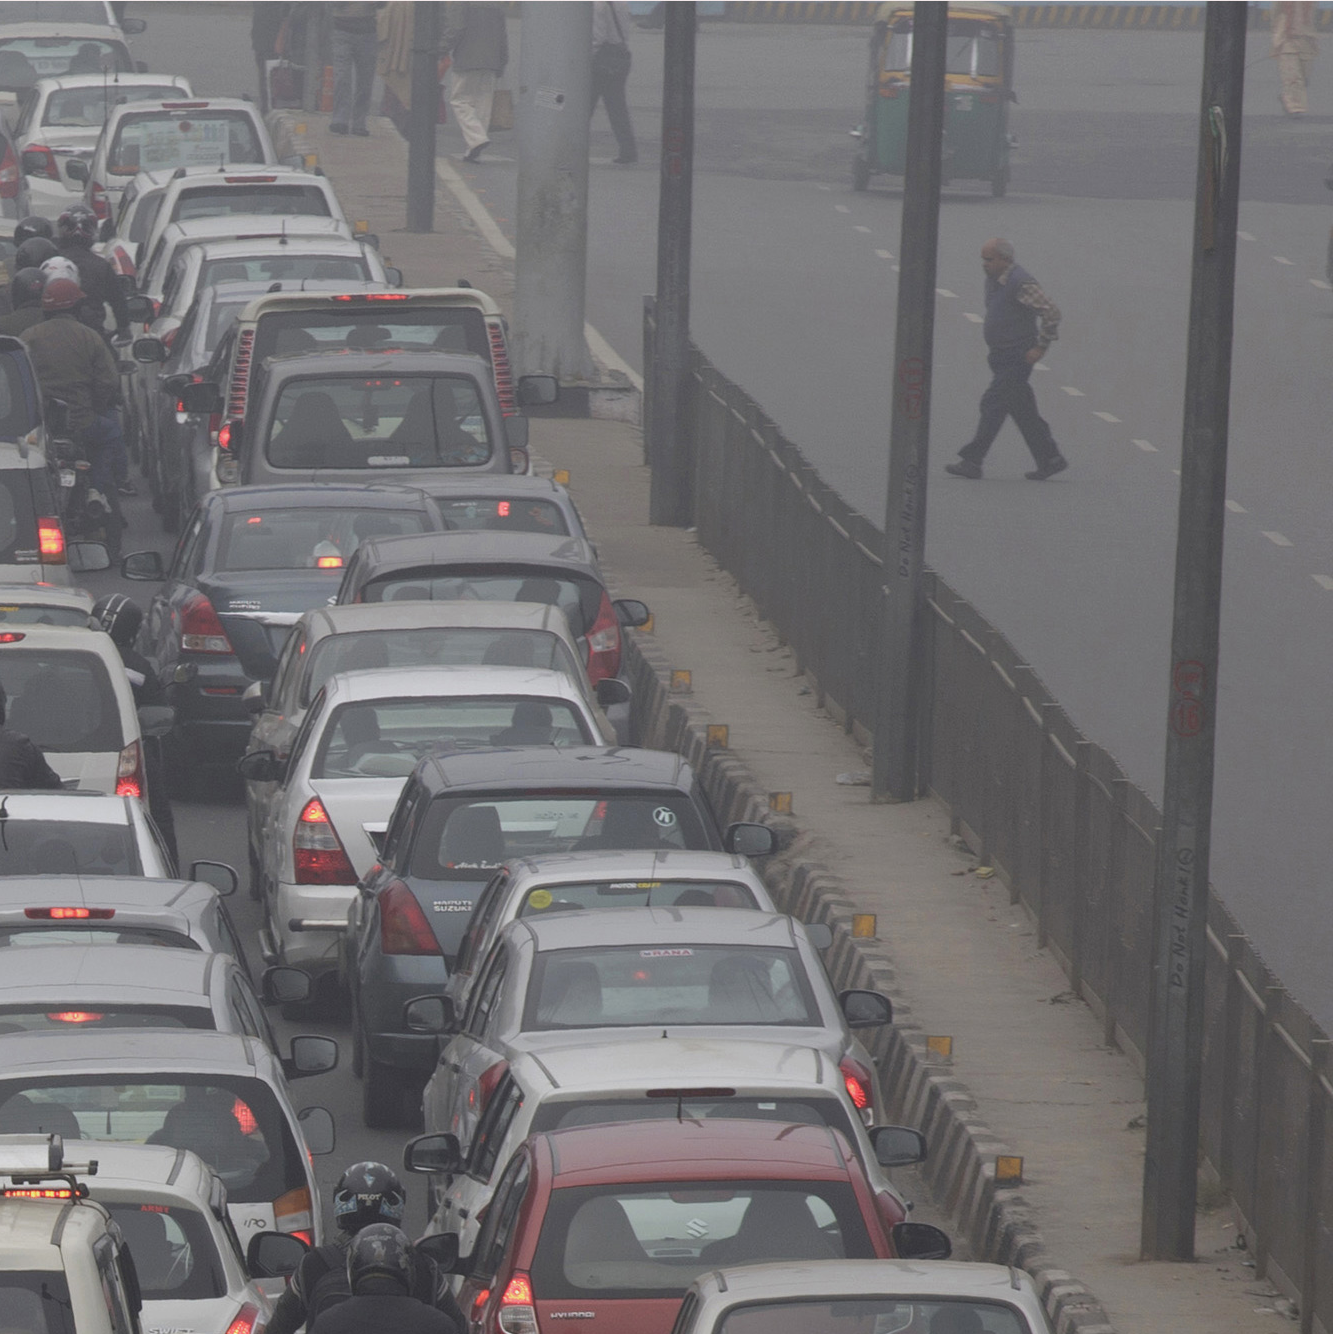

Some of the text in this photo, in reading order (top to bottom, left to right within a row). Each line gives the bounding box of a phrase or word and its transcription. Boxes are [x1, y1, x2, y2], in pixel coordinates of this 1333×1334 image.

[1172, 924, 1187, 956] Not
[1171, 961, 1185, 989] Do
[357, 1193, 382, 1201] PILOT
[550, 1312, 596, 1320] HYUNDAI
